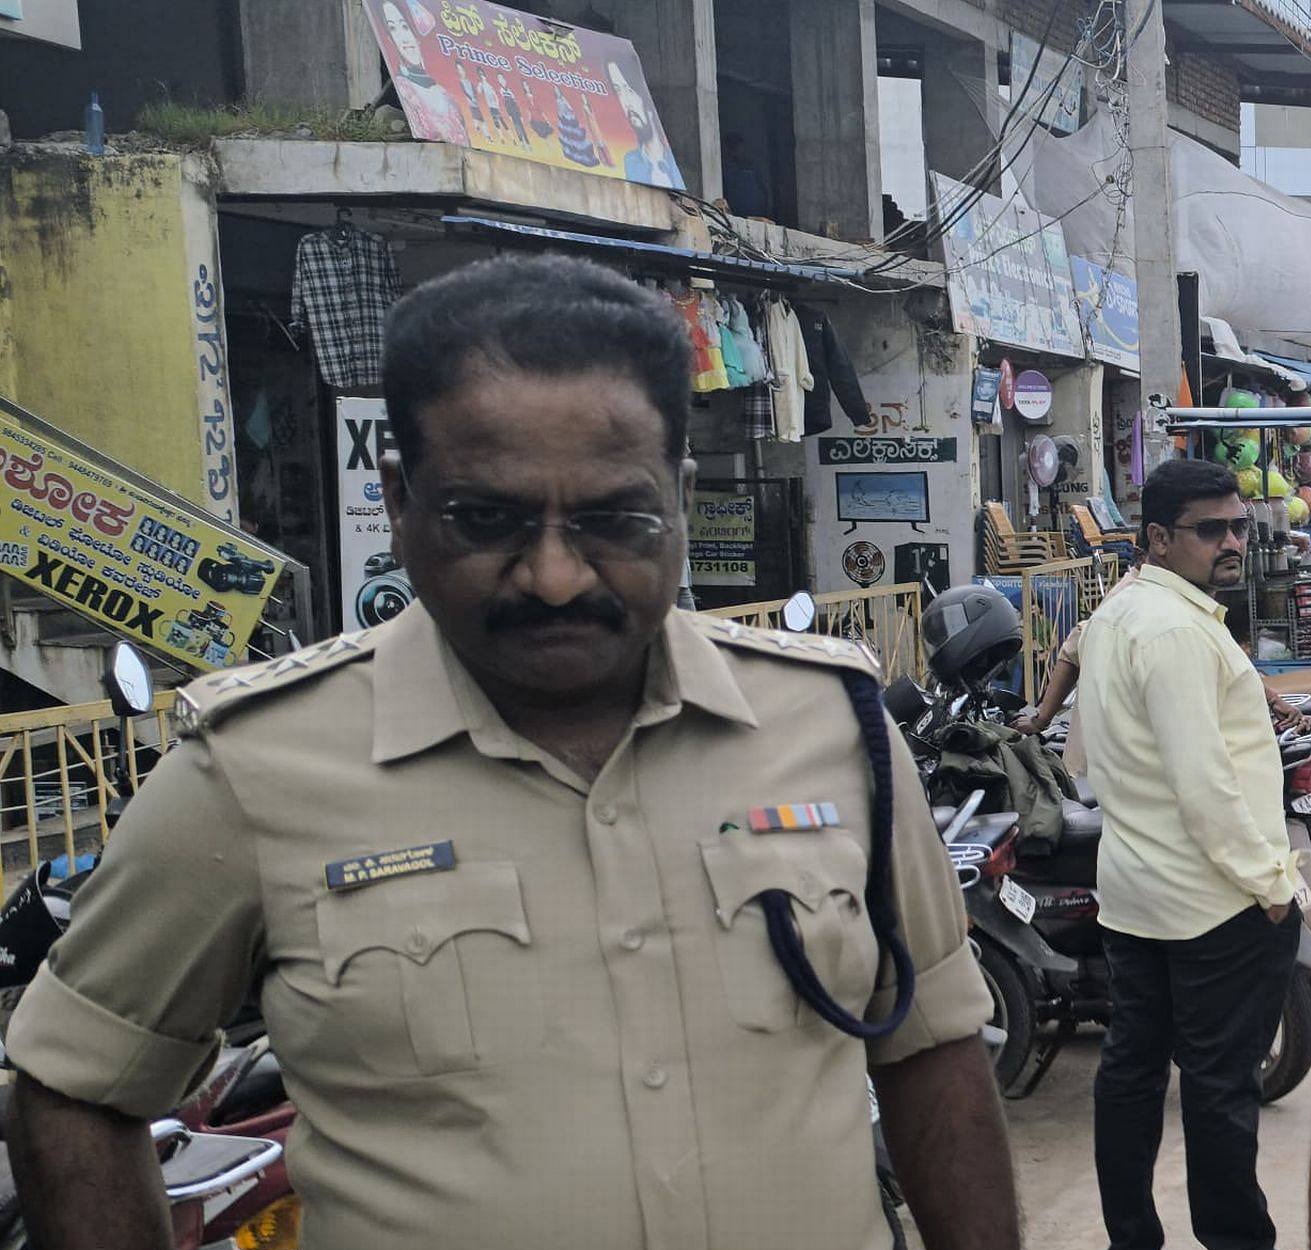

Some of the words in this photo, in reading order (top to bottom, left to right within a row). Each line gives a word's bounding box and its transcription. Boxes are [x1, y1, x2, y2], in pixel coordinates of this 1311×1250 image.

[437, 34, 513, 72] Prince
[515, 55, 609, 96] Selection
[19, 523, 31, 538] &
[366, 523, 381, 533] 4K
[23, 550, 166, 639] XEROX
